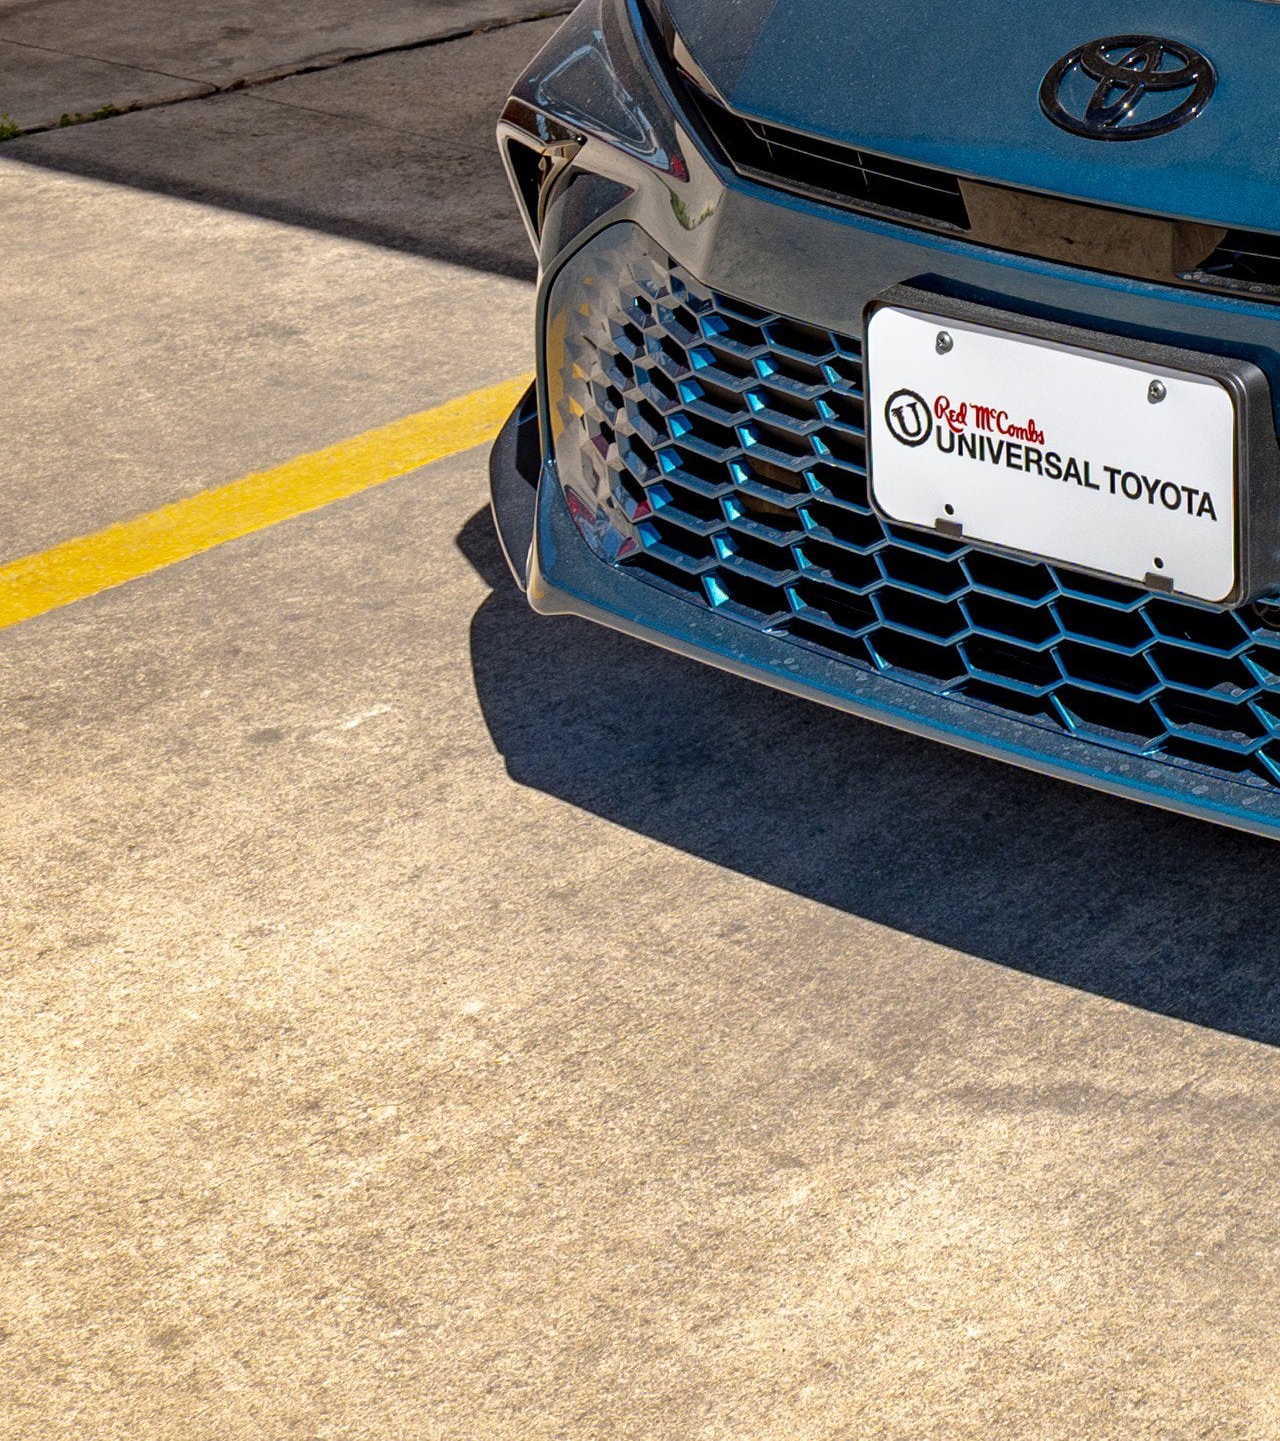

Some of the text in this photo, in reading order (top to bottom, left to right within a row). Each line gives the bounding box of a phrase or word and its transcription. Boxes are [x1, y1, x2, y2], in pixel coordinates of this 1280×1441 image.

[933, 394, 1046, 446] Red McCombs
[935, 424, 1218, 522] UNIVERSAL TOYOTA
